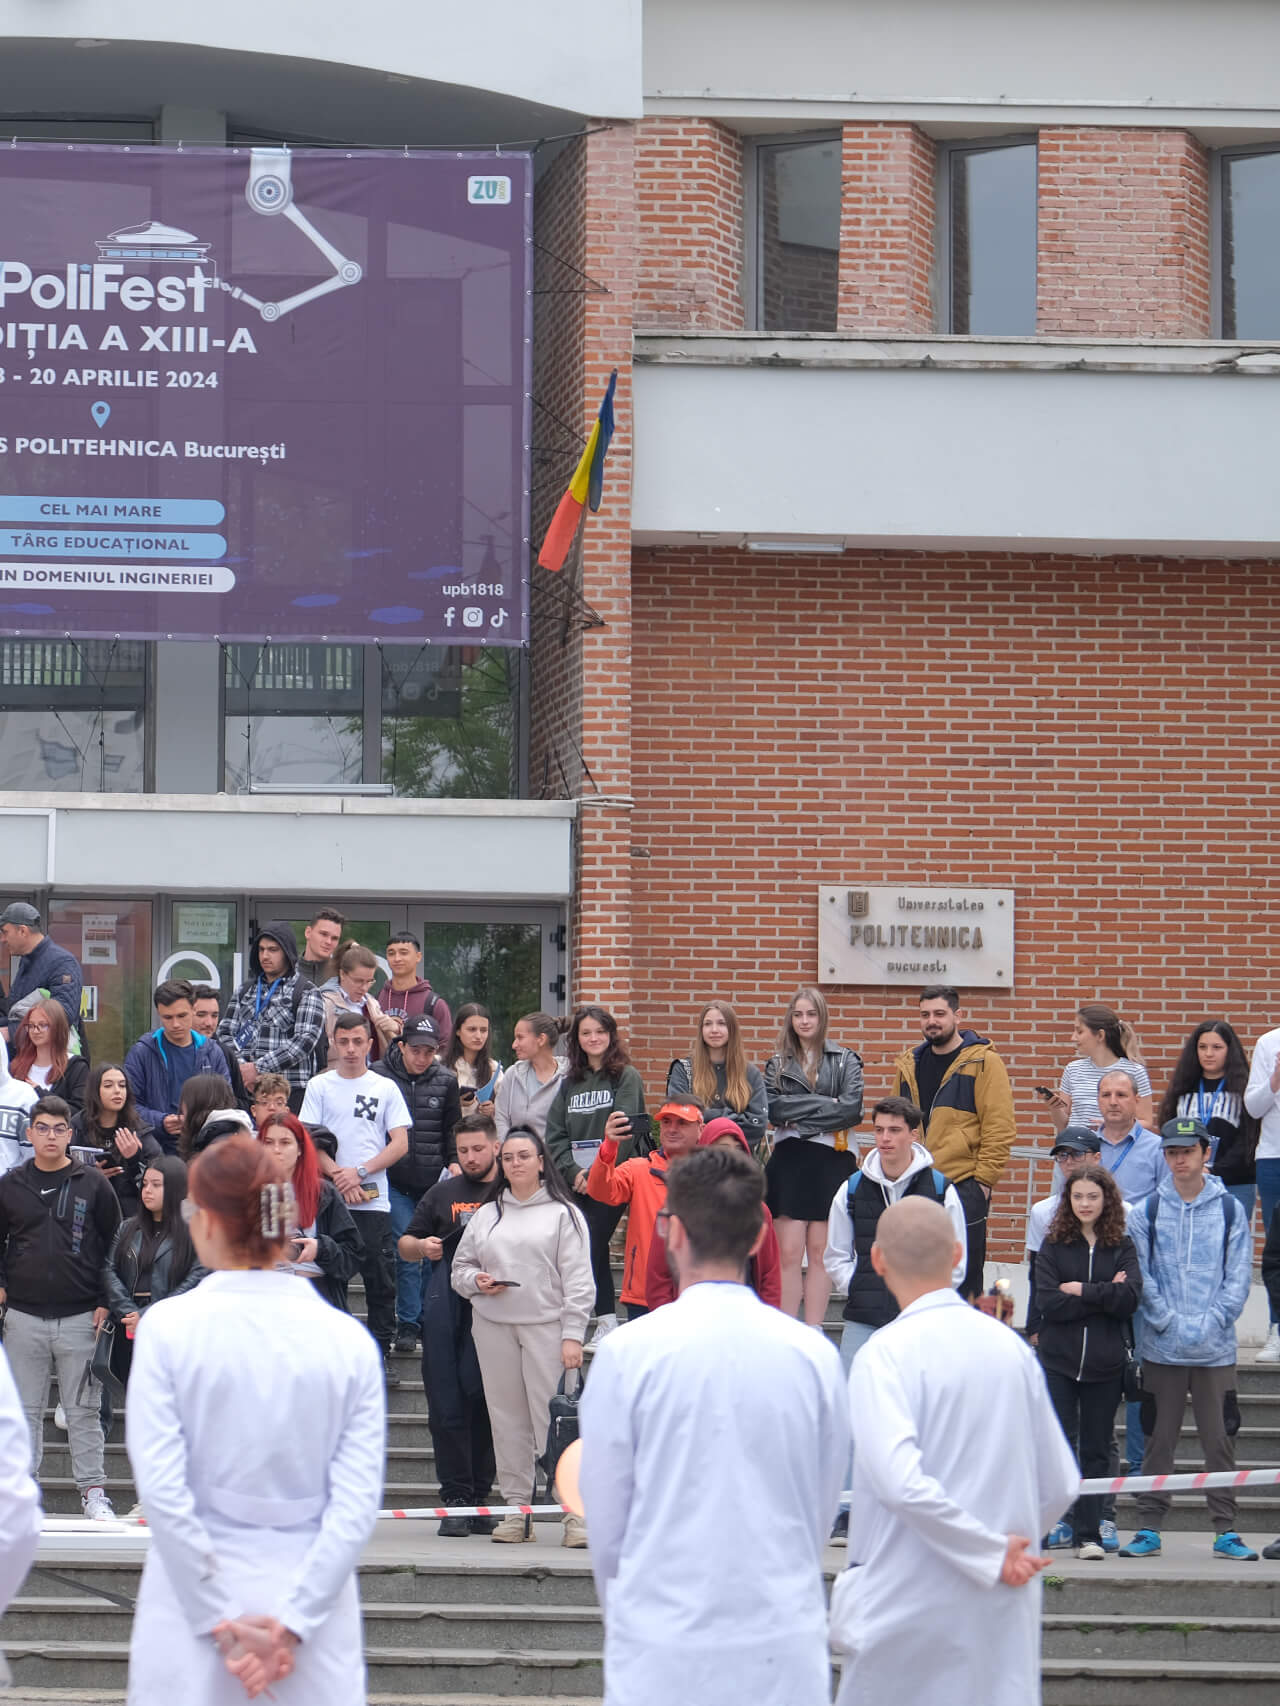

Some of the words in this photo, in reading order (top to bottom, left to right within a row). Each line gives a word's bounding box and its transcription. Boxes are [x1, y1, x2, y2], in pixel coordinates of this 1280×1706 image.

[472, 180, 498, 200] ZU
[99, 325, 129, 351] A
[139, 326, 258, 354] XIII-A
[29, 367, 56, 385] 20
[61, 368, 159, 388] APRILIE
[165, 370, 219, 389] 2024
[15, 437, 178, 457] POLITEHNICA
[184, 441, 286, 466] București
[39, 503, 71, 516] CEL
[76, 504, 108, 517] MAI
[113, 505, 162, 518] MARE
[10, 532, 59, 548] TÂRG
[63, 536, 190, 553] EDUCAȚIONAL
[22, 570, 116, 584] DOMENIUL
[119, 572, 214, 586] INGINERIEI
[442, 582, 504, 598] upb1818
[849, 924, 984, 950] POLITEHNICA
